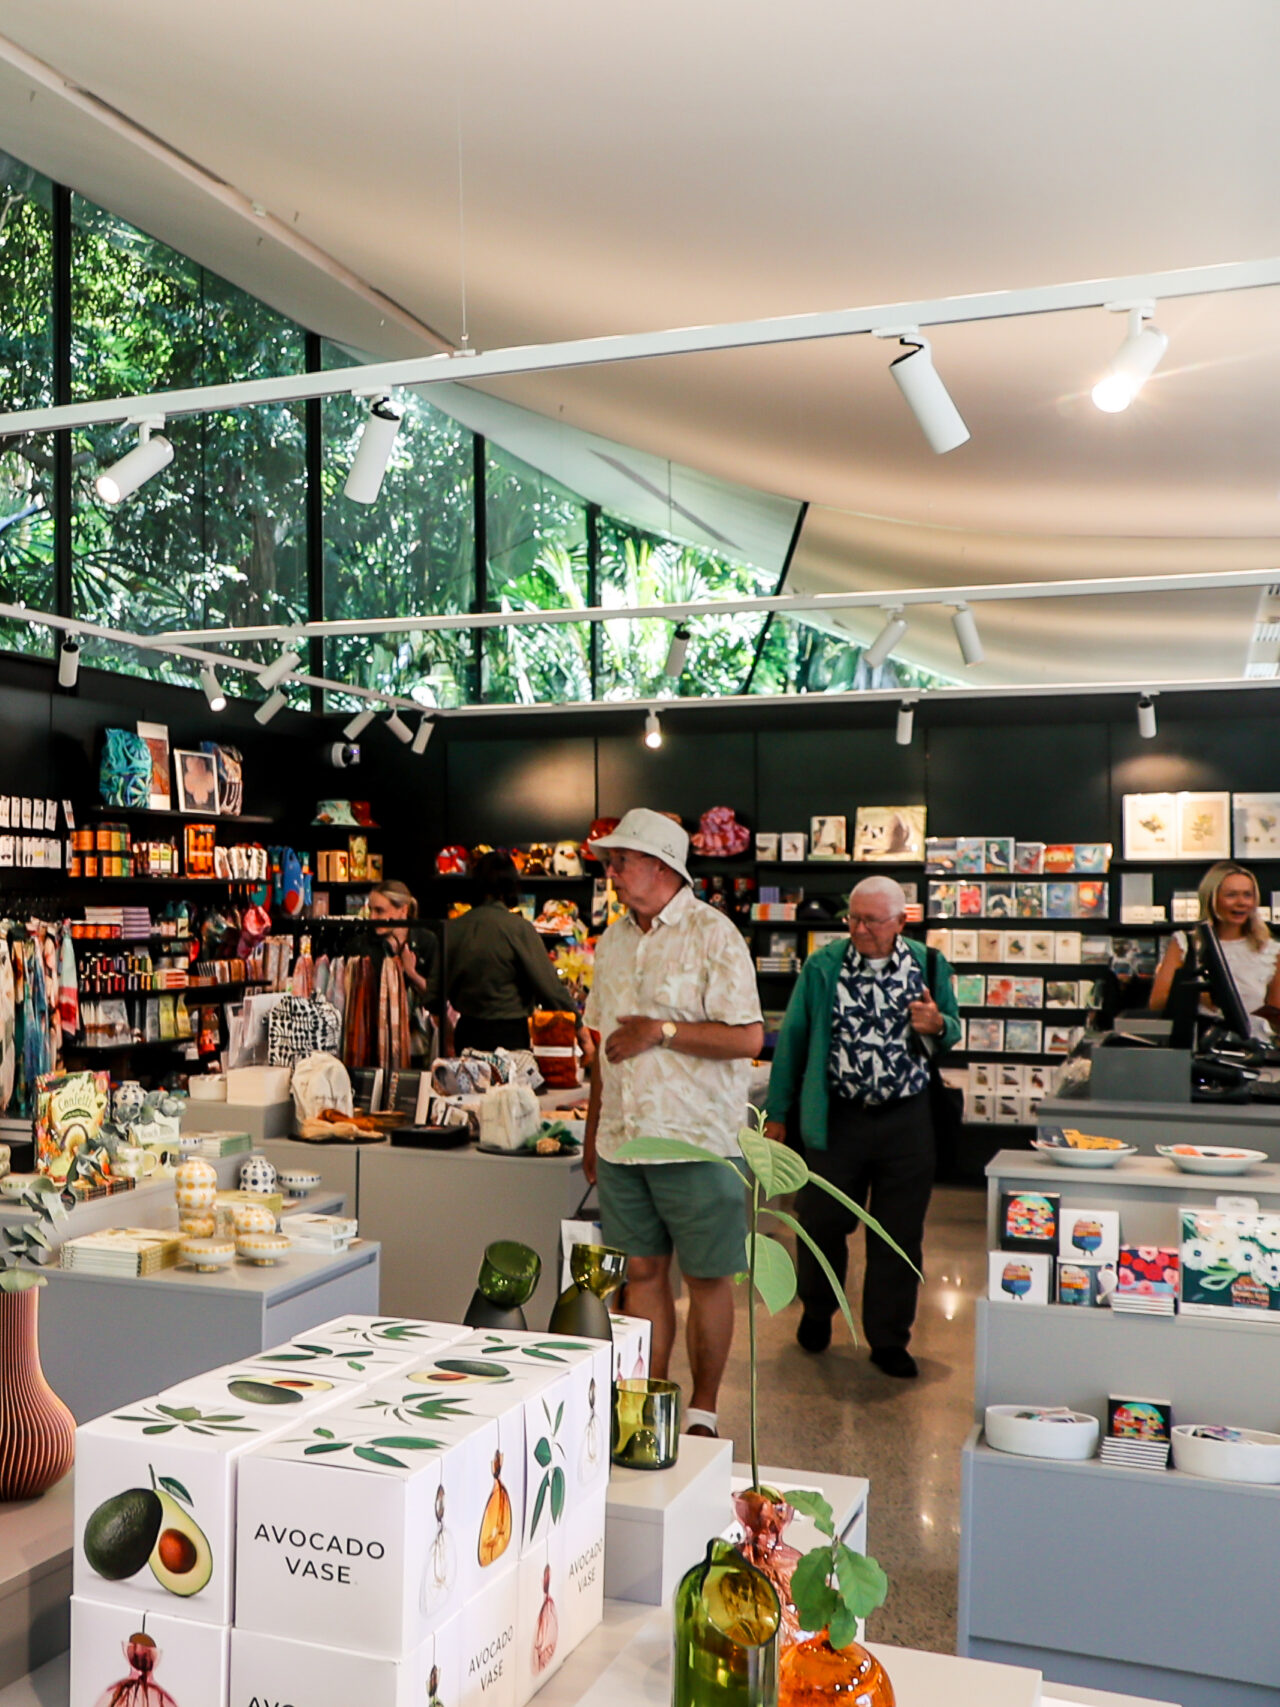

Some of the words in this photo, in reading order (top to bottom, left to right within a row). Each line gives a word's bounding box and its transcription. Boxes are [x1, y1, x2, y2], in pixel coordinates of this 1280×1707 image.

[254, 1523, 385, 1560] AVOCADO
[285, 1556, 351, 1584] VASE
[577, 1566, 595, 1593] VASE
[468, 1625, 513, 1677] AVOCADO
[480, 1659, 503, 1691] VASE
